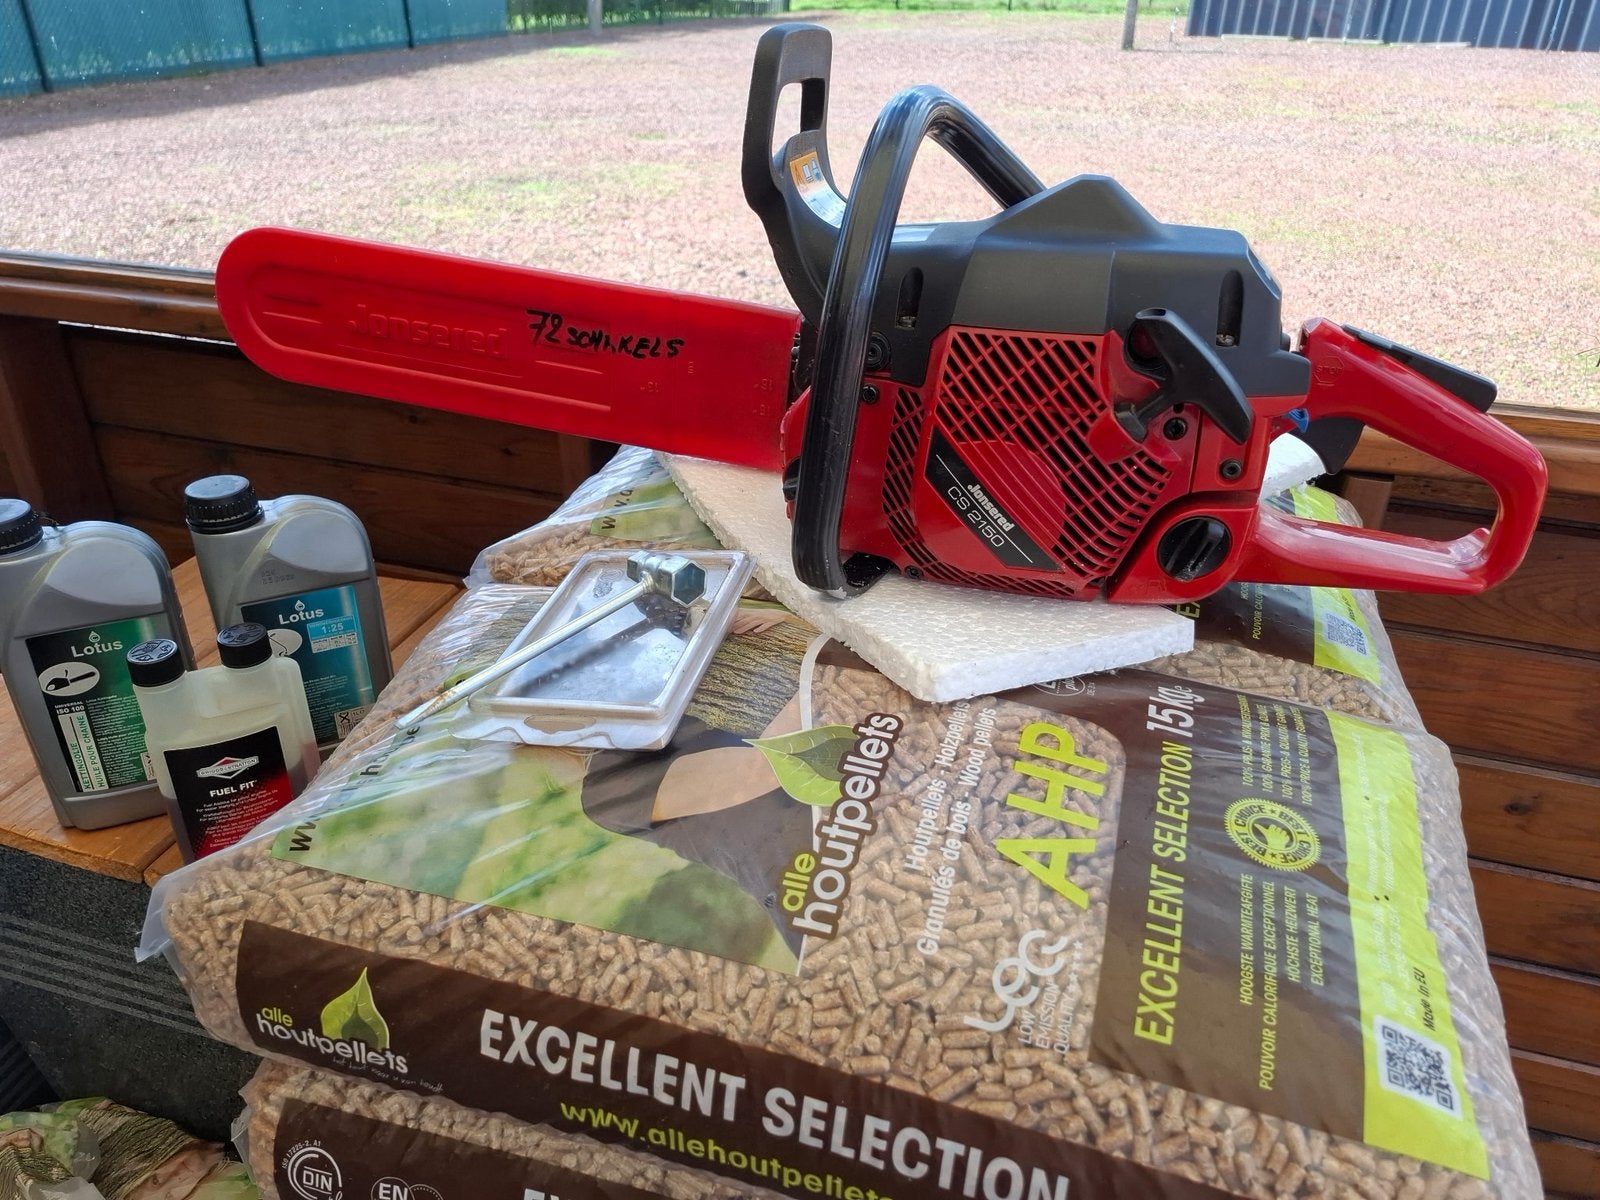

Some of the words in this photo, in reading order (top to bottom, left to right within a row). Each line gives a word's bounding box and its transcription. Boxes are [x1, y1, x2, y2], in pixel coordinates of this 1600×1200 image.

[347, 303, 508, 360] Jonsered
[526, 308, 563, 347] 72
[947, 486, 970, 510] CS
[967, 510, 1005, 547] 2150
[967, 484, 1015, 532] Jonsered
[279, 608, 324, 625] Lotus
[321, 622, 344, 633] 1:25
[1252, 610, 1263, 640] POUVOIR
[71, 641, 124, 658] Lotus
[56, 706, 69, 715] ISO
[71, 705, 85, 713] 100
[973, 707, 997, 747] pellets
[77, 715, 92, 745] CHAINE
[71, 743, 92, 790] KETTINGOLIE
[86, 744, 98, 765] POUR
[958, 748, 986, 787] Wood
[92, 765, 105, 788] HUILE
[210, 786, 238, 797] FUEL
[240, 780, 255, 791] FIT
[904, 779, 947, 871] Houtpellets
[934, 701, 971, 767] Holzpellets
[1242, 766, 1254, 787] 100%
[1261, 774, 1274, 793] 100%
[1281, 779, 1293, 800] 100%
[1300, 763, 1312, 785] PRICE
[1152, 740, 1193, 863] SELECTION
[1302, 785, 1313, 806] 100%
[792, 715, 899, 933] houtpellets
[947, 801, 972, 834] bois
[996, 722, 1108, 911] AHP
[1234, 804, 1266, 828] CHOICE
[1279, 810, 1310, 837] BEST
[940, 839, 962, 861] de
[1236, 830, 1267, 857] BEST
[1280, 840, 1312, 864] CHOICE
[782, 853, 815, 911] alle
[916, 865, 956, 955] Granulés
[1240, 873, 1254, 951] WARMTEAFGIFTE
[1262, 881, 1277, 950] EXCEPTIONNEL
[1284, 886, 1299, 933] HEIZWERT
[1305, 893, 1320, 918] HEAT
[1134, 864, 1185, 1046] EXCELLENT
[1308, 921, 1325, 986] EXCEPTIONAL
[1240, 952, 1254, 1005] HOOGSTE
[1263, 951, 1279, 1026] CALORIFIQUE
[1413, 966, 1427, 985] EU
[261, 1006, 293, 1027] alle
[1018, 1010, 1036, 1044] LOW
[1036, 980, 1060, 1049] EMISSION
[1053, 992, 1075, 1055] QUALITY
[1420, 999, 1436, 1031] Made
[256, 1014, 409, 1074] houtpellets
[1259, 1028, 1277, 1091] POUVOIR
[480, 1008, 746, 1122] EXCELLENT
[761, 1087, 1070, 1200] SELECTION
[560, 1102, 893, 1200] www.allehoutpellet
[302, 1170, 333, 1192] DIN
[378, 1183, 408, 1200] EN
